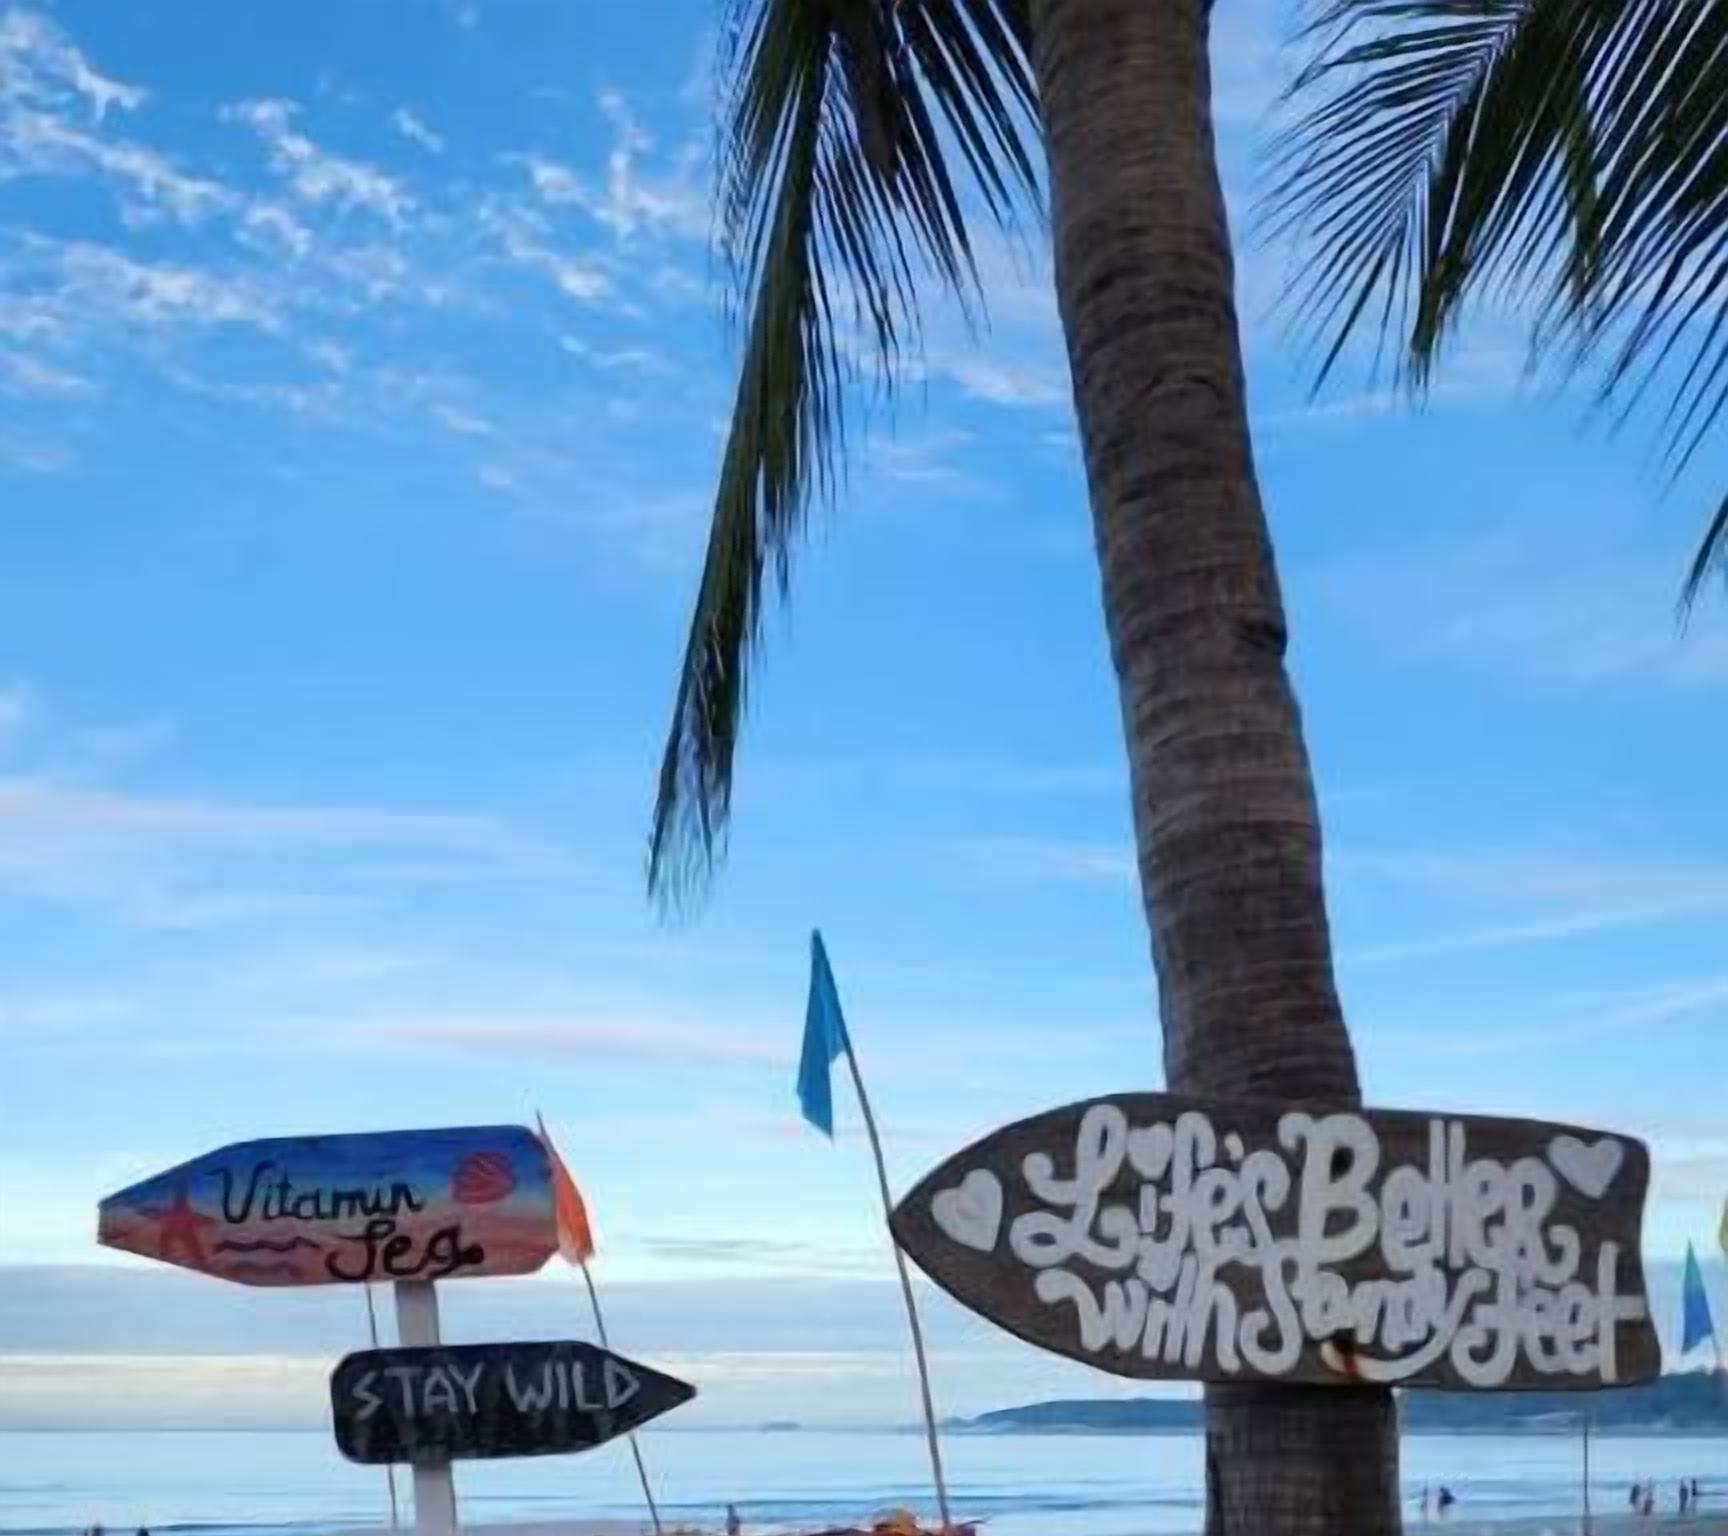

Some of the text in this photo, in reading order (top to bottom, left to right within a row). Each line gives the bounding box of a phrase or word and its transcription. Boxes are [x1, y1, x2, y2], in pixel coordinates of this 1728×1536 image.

[204, 1160, 425, 1224] Vitamin
[1009, 1103, 1291, 1293] Life's
[325, 1219, 484, 1281] Sea
[351, 1360, 640, 1421] STAY WILD
